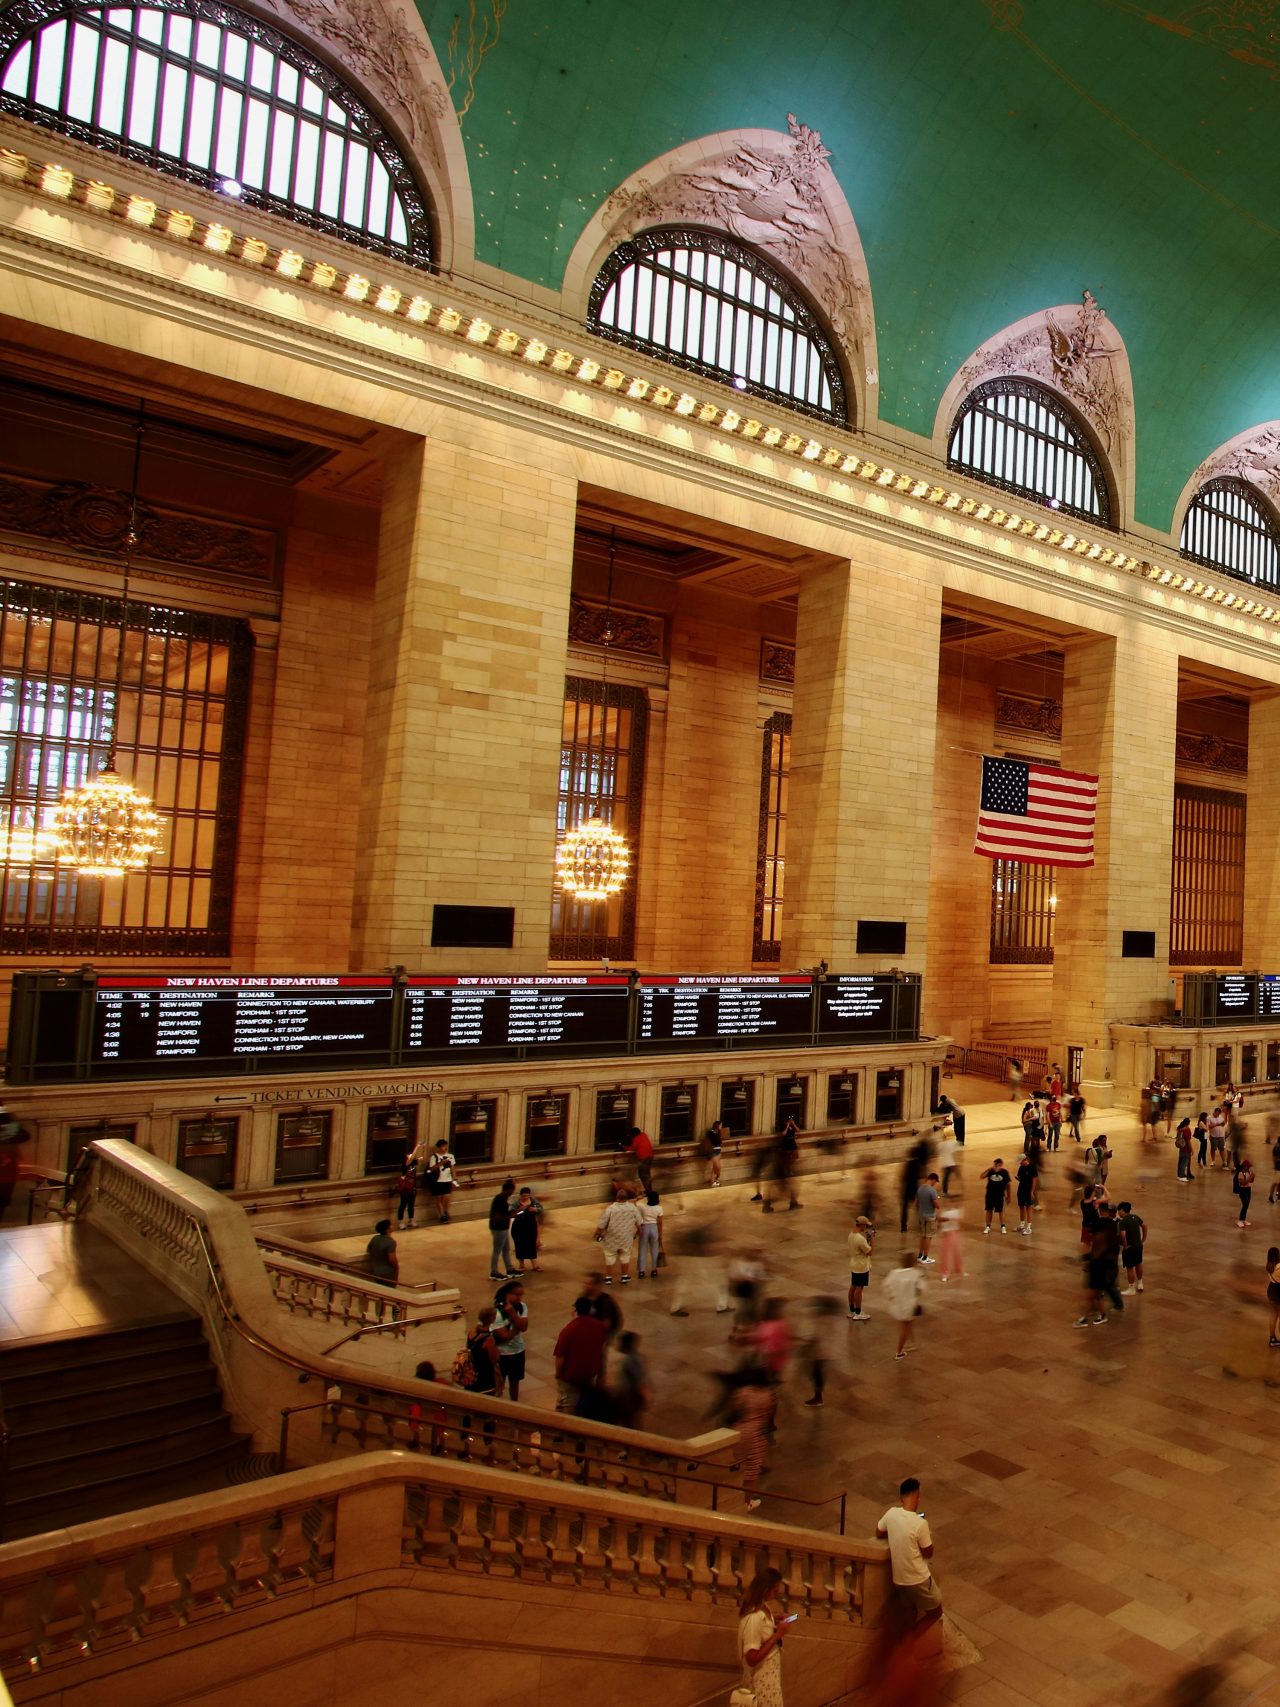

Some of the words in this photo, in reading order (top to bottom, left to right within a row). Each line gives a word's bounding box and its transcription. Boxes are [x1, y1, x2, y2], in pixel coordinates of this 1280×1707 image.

[167, 978, 196, 986] NEW
[197, 978, 239, 986] HAVEN
[242, 978, 268, 986] LINE
[270, 977, 339, 986] DEPARTURES
[252, 1091, 306, 1103] TICKET
[307, 1086, 373, 1099] VENDING
[376, 1082, 444, 1095] MACHINES
